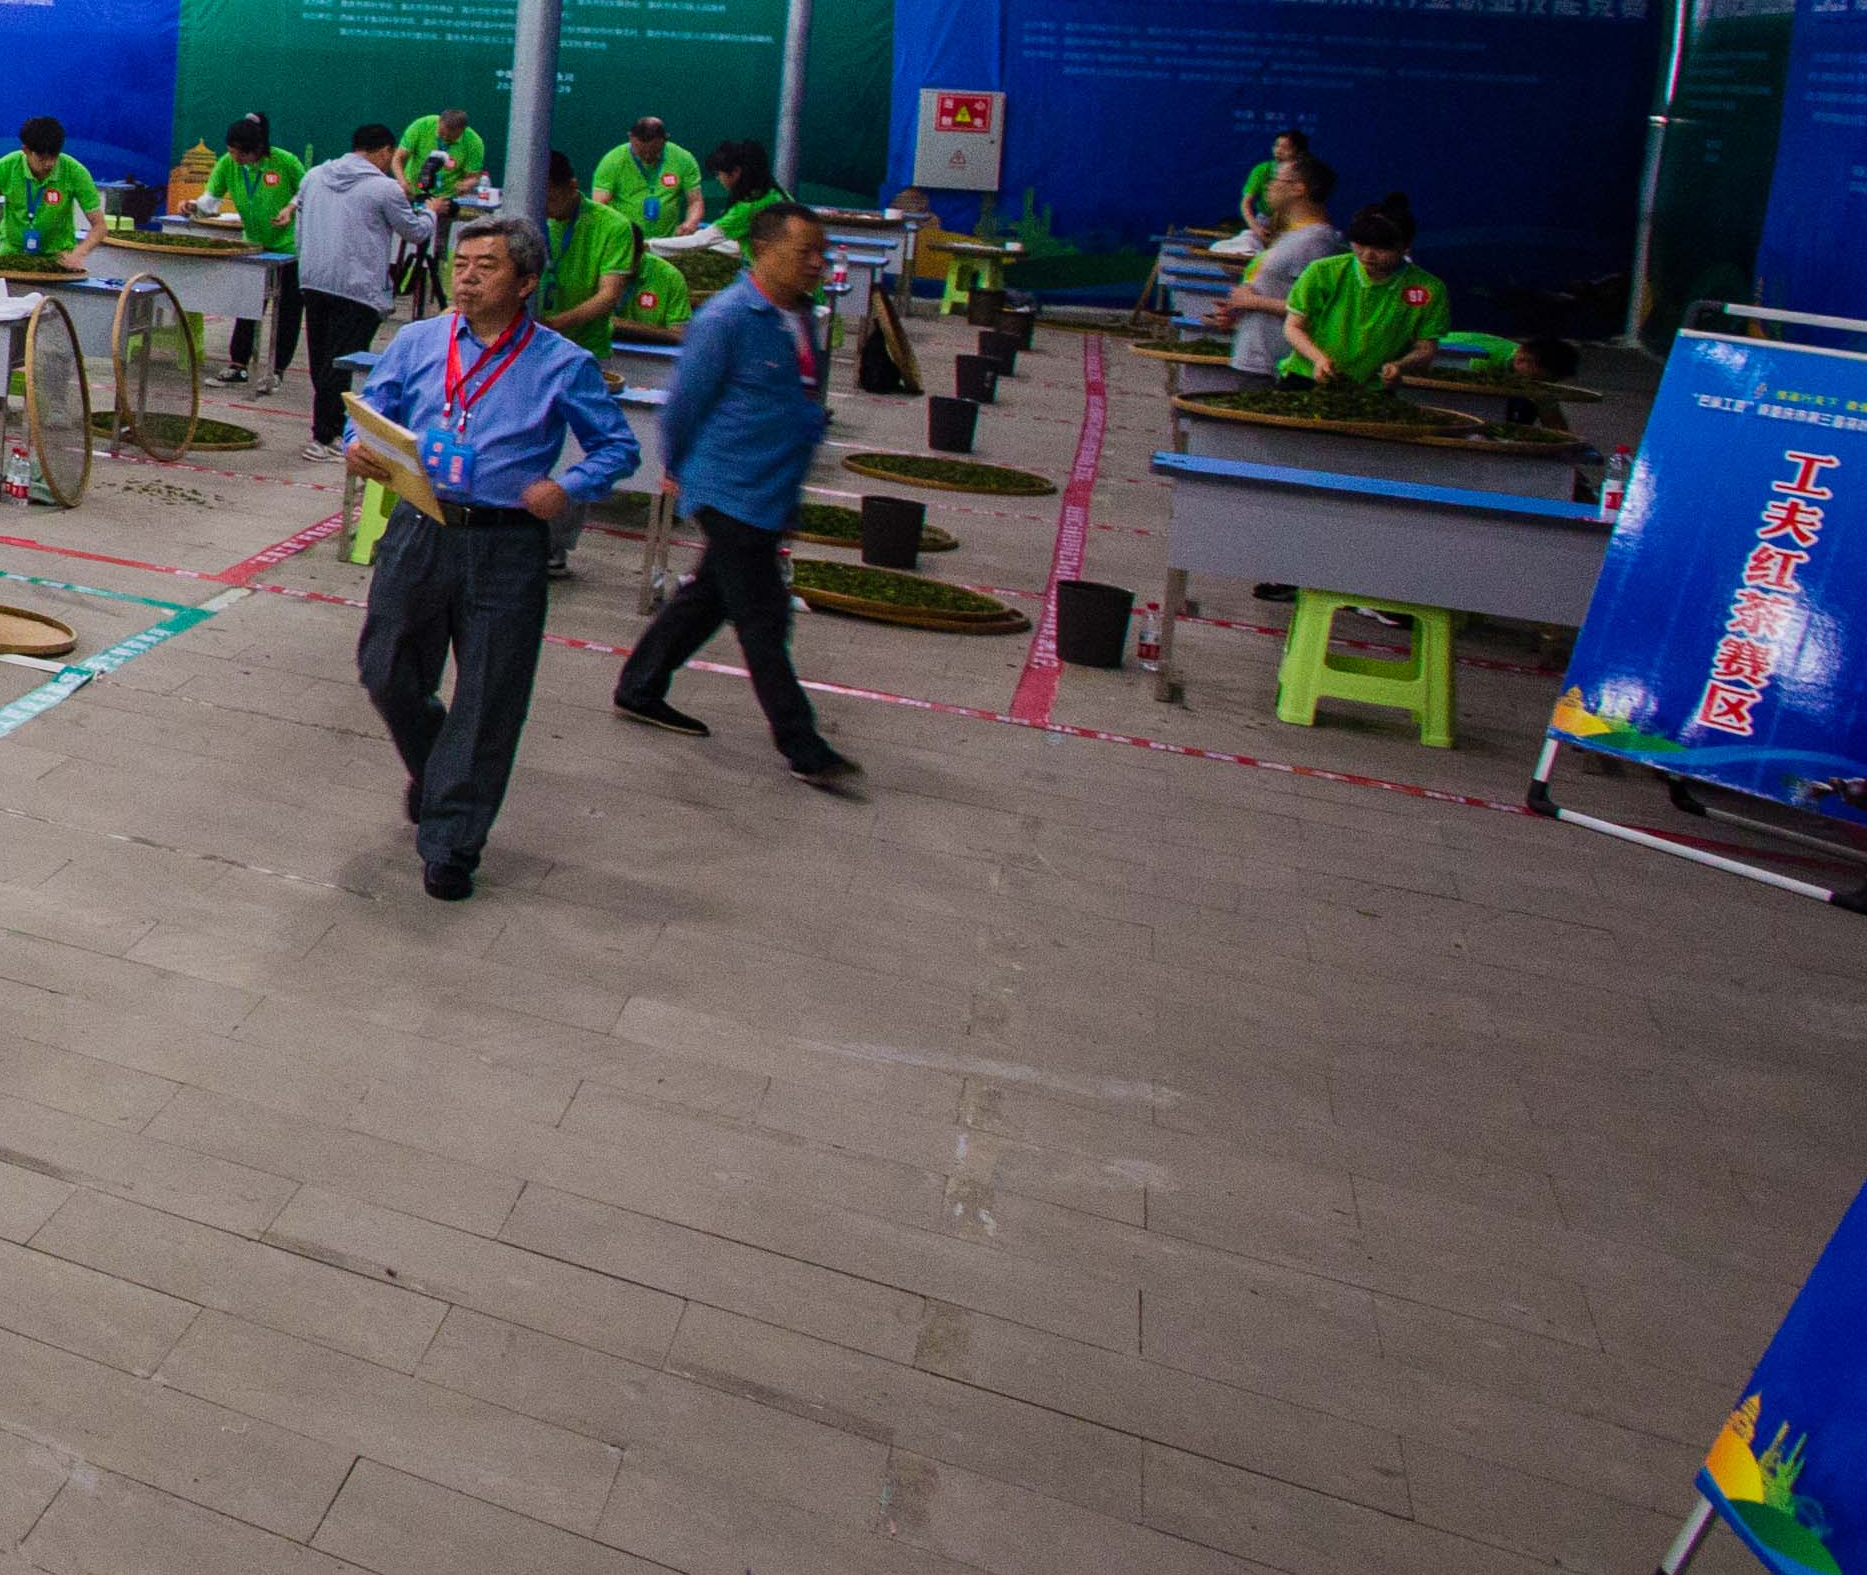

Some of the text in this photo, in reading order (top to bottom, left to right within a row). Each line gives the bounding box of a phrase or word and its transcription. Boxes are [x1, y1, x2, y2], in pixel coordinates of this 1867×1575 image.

[1697, 449, 1841, 737] 工夫红茶赛区
